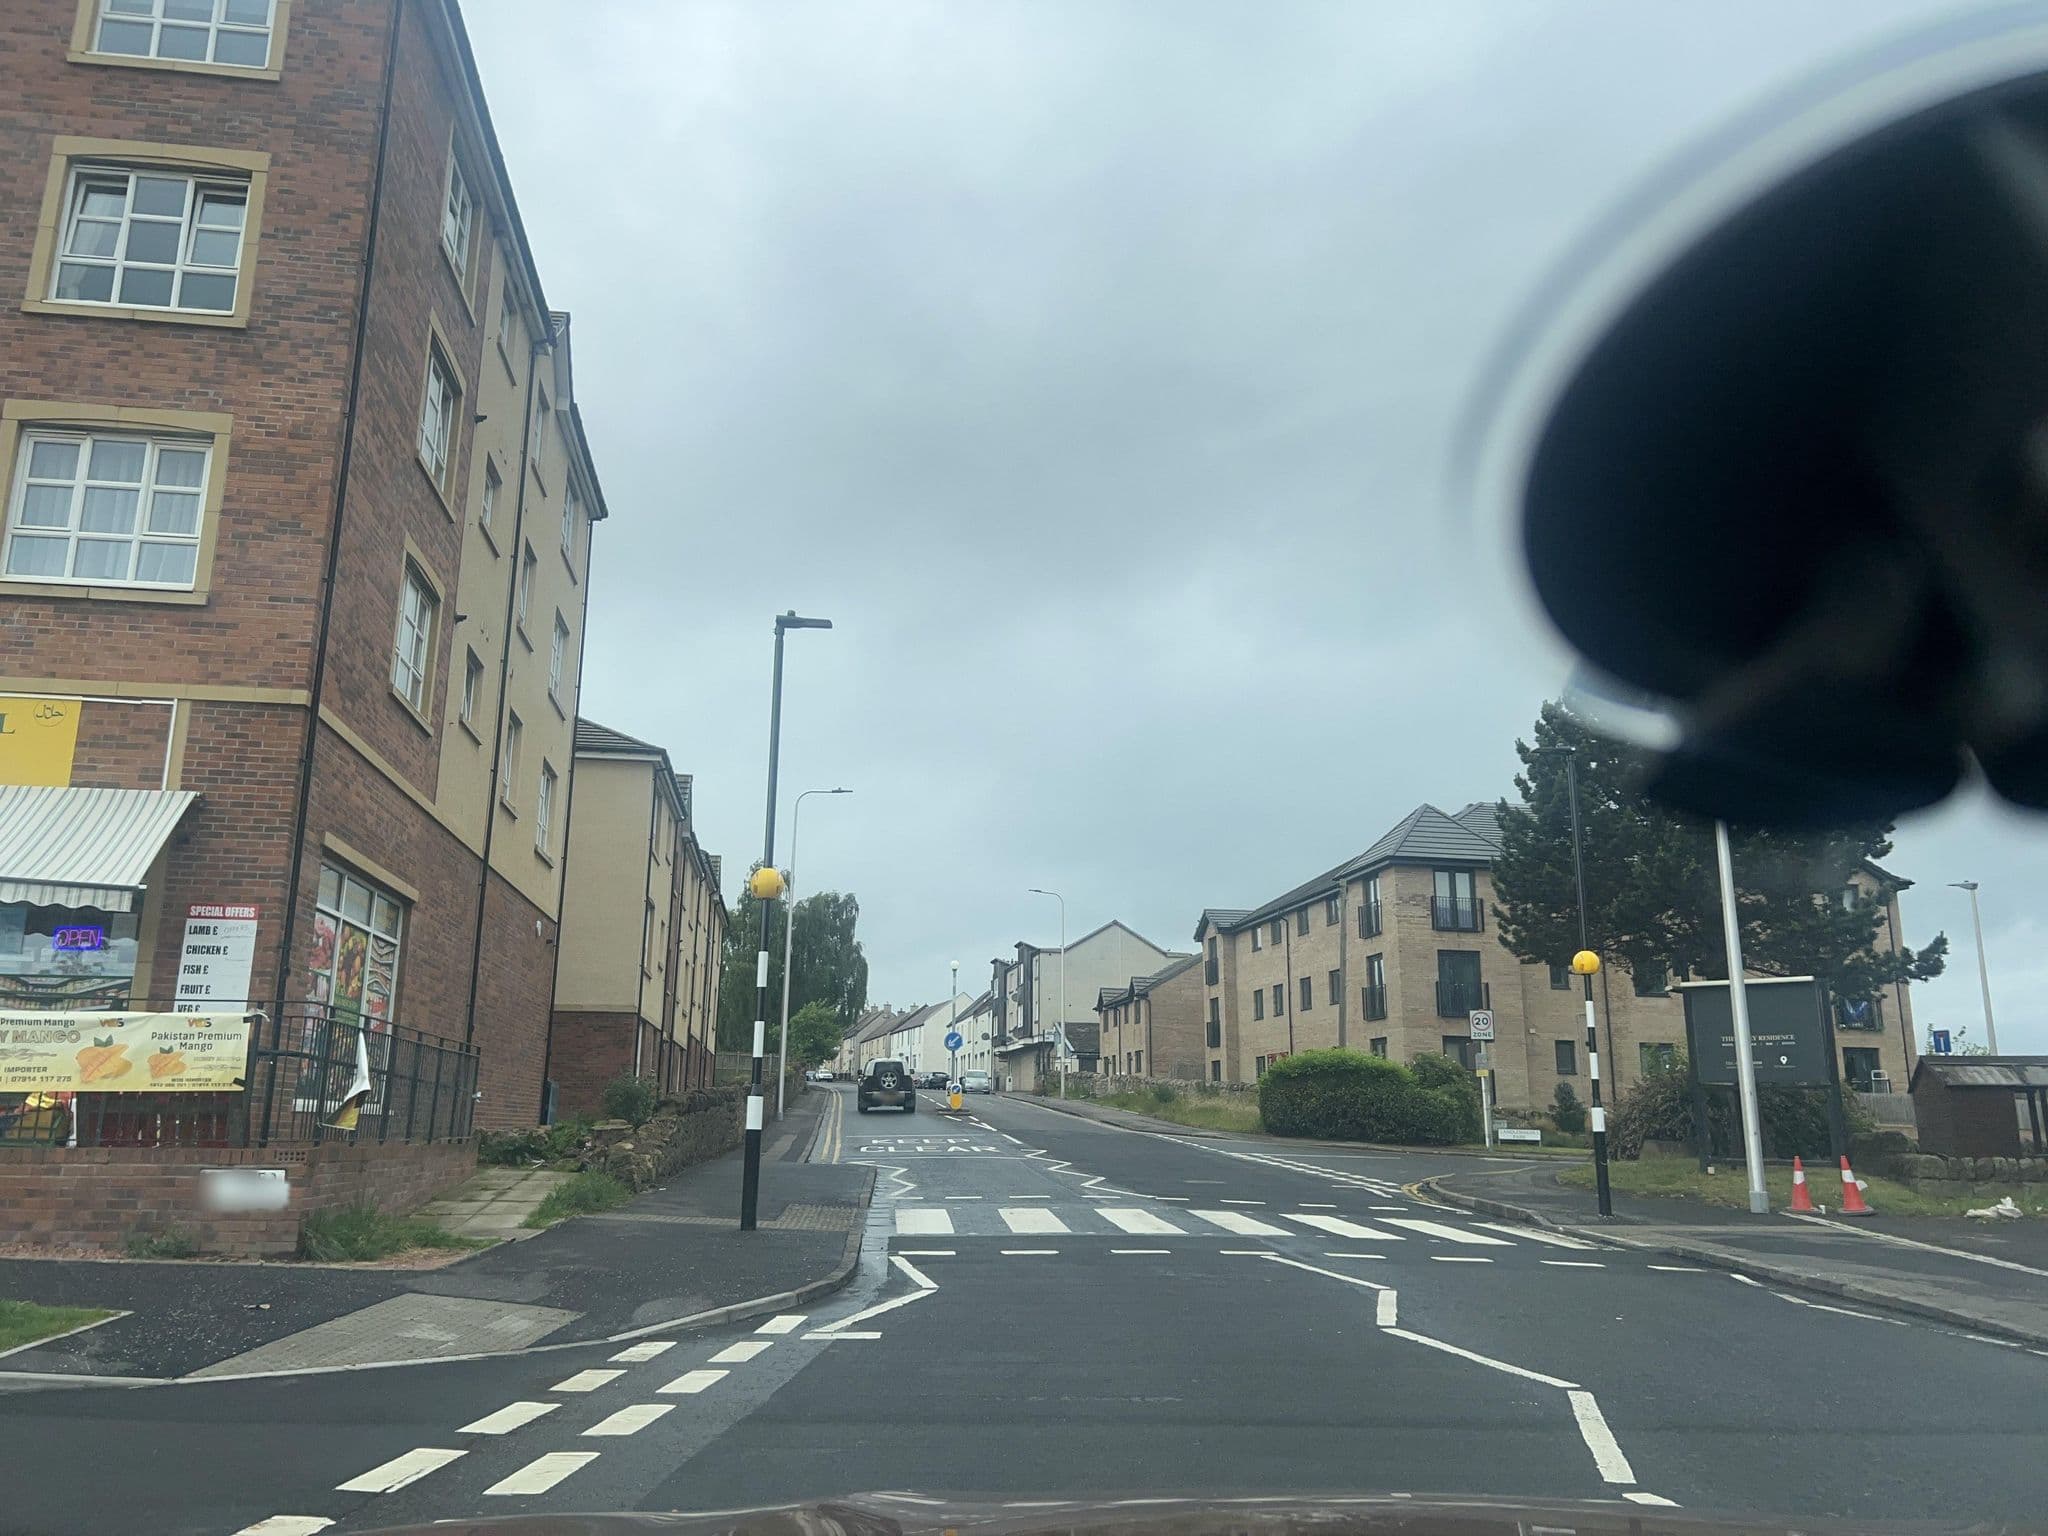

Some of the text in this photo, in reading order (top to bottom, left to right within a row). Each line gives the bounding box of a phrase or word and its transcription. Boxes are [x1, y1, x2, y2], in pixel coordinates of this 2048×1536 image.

[190, 905, 256, 918] SPECIAL OFFERS
[188, 925, 219, 936] LAMB £
[56, 929, 101, 947] OPEN
[186, 945, 229, 955] CHICKEN £
[183, 964, 209, 975] FISH £
[180, 984, 211, 995] FRUIT £
[0, 1018, 75, 1028] Premium Mango
[1474, 1017, 1489, 1026] 20
[12, 1030, 81, 1043] MANGO
[151, 1031, 242, 1041] Pakistan Premium
[179, 1042, 213, 1052] Mango
